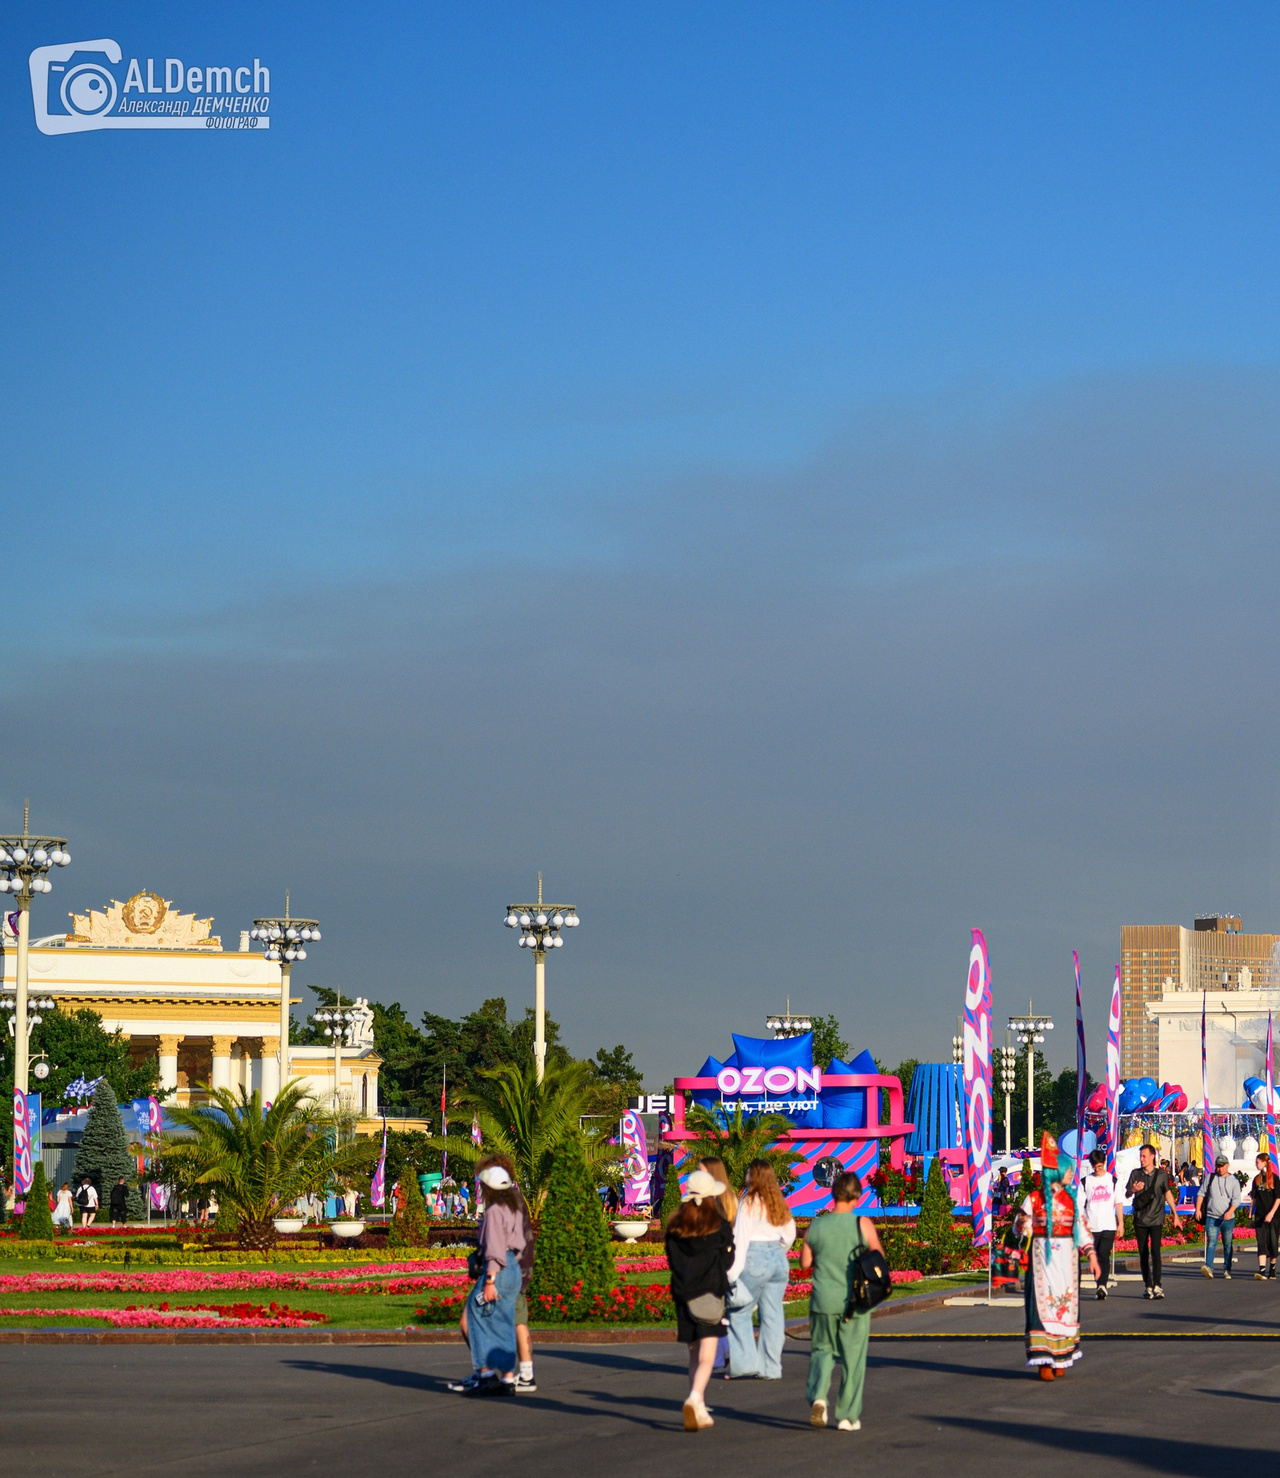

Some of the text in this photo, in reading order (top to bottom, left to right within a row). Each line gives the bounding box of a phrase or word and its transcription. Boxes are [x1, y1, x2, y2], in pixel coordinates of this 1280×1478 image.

[718, 1067, 820, 1094] OZON
[758, 1101, 783, 1114] где
[787, 1101, 819, 1114] уют
